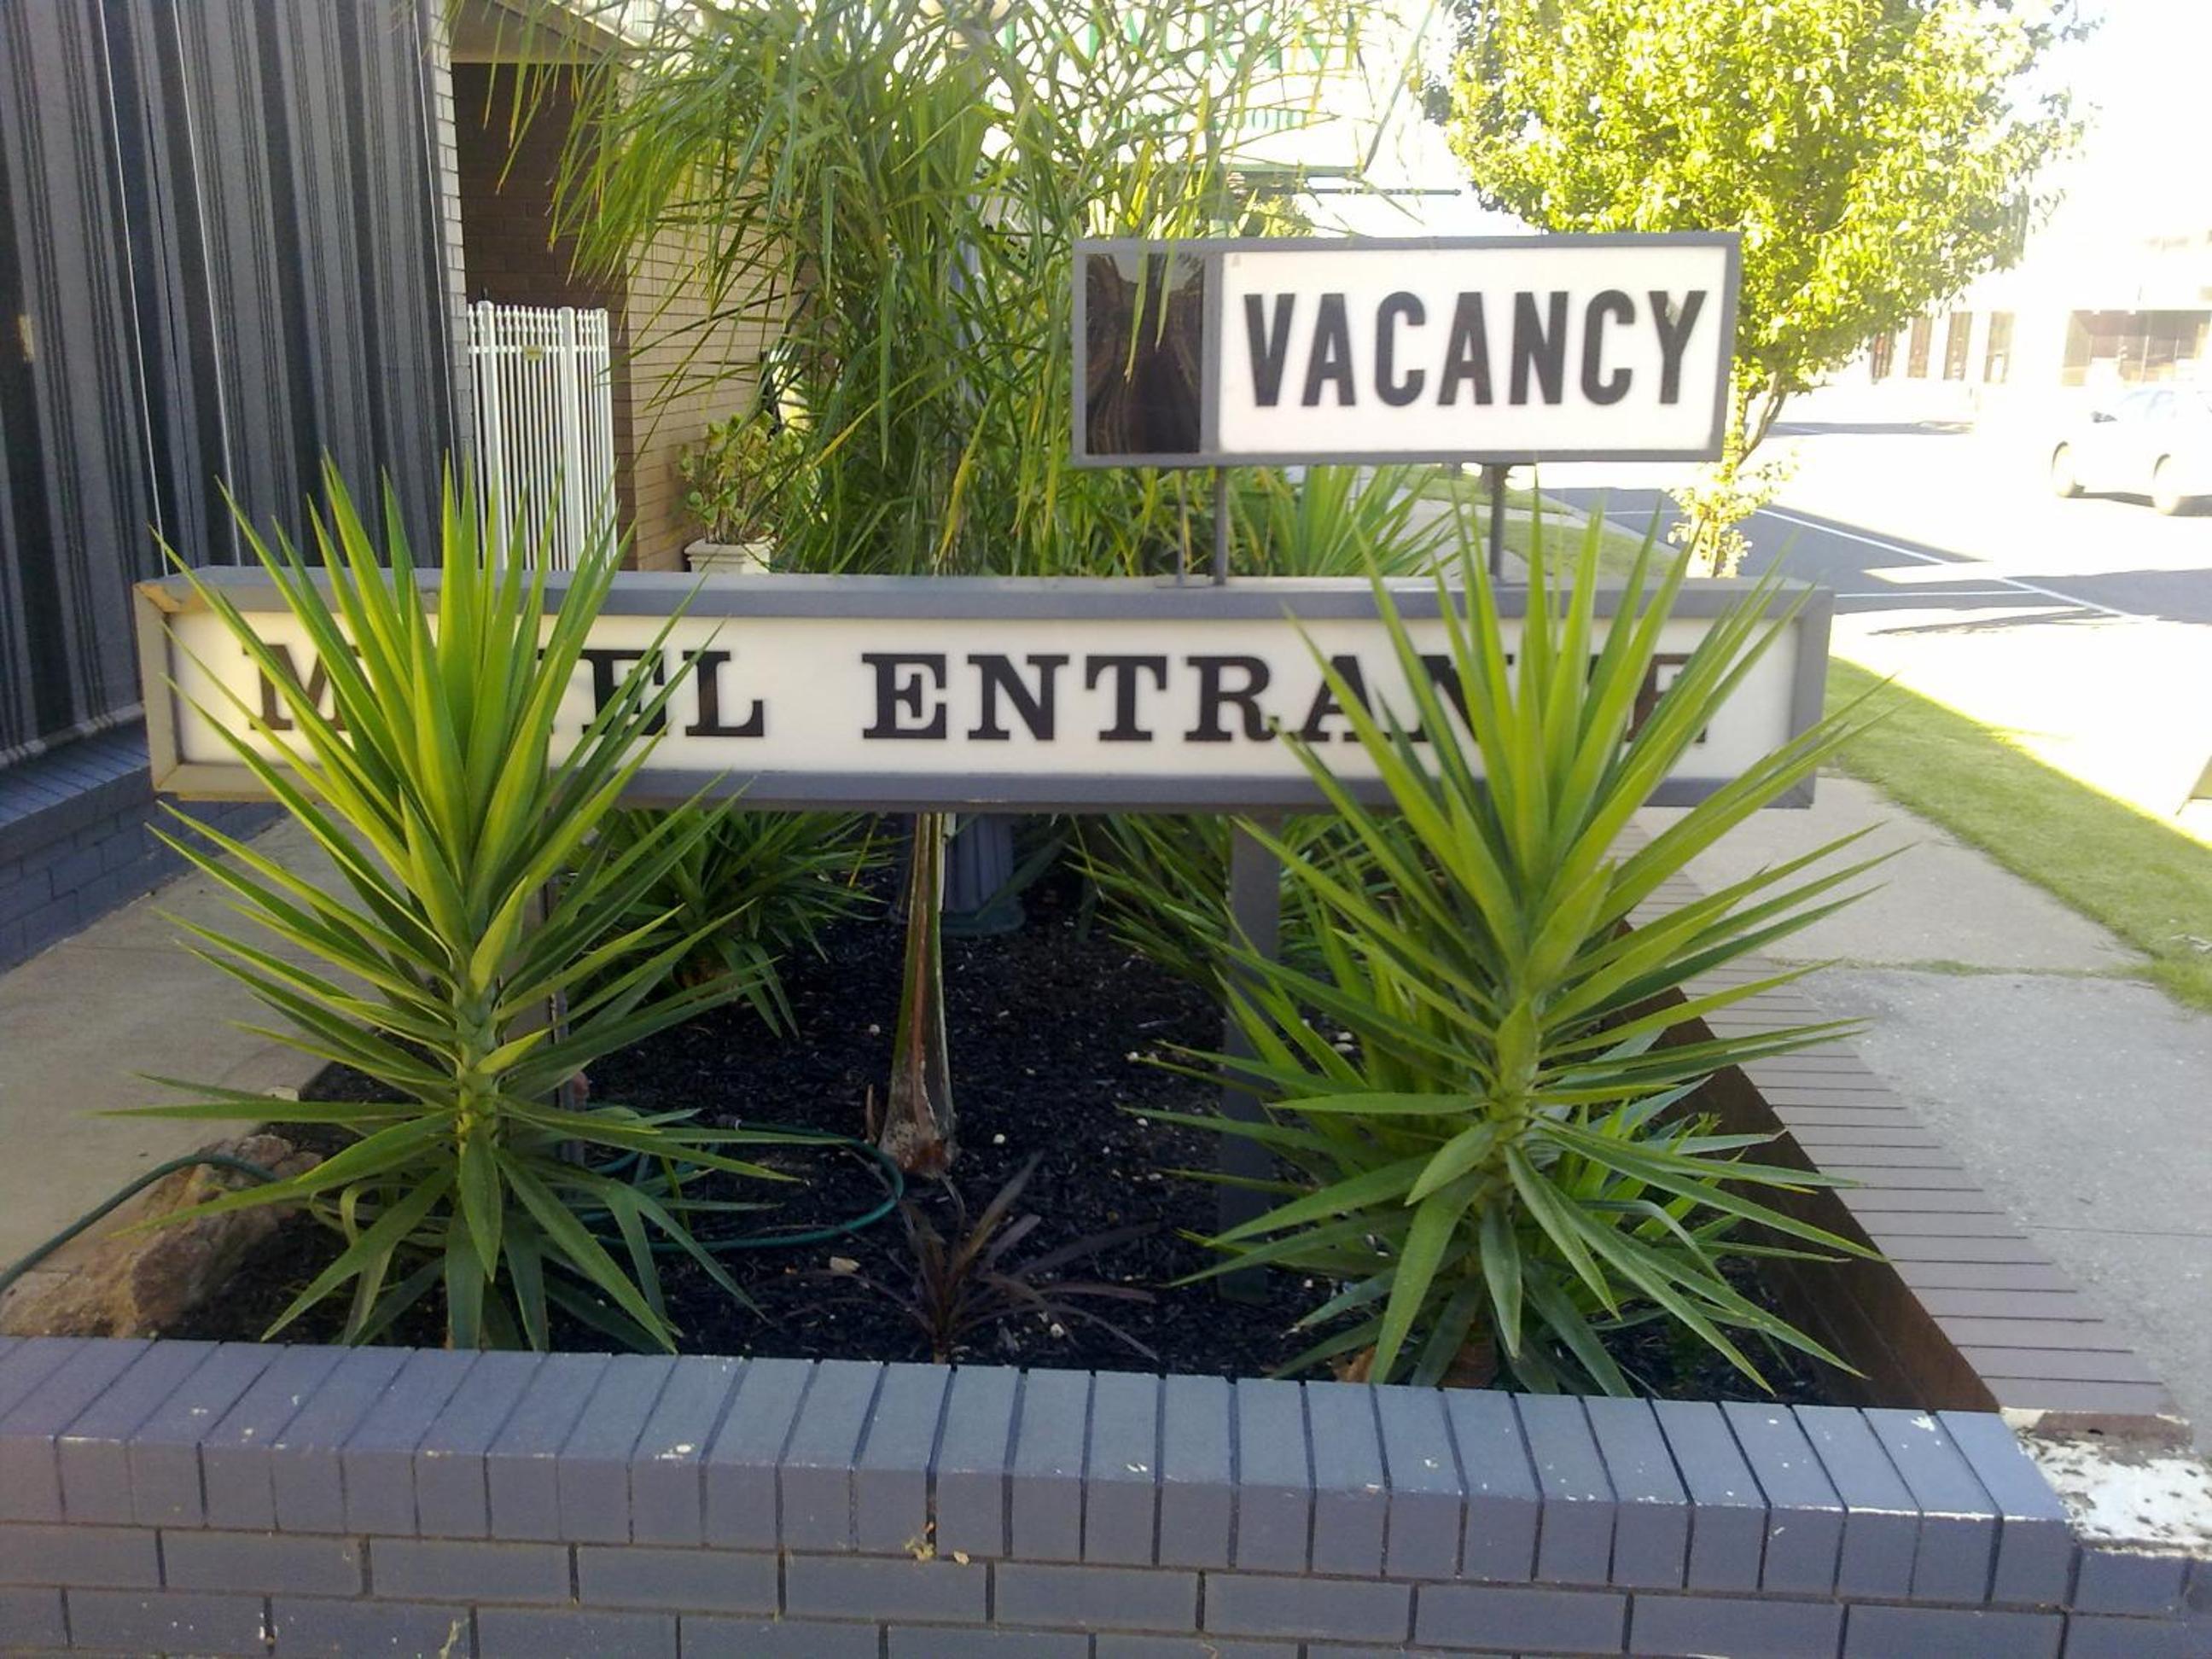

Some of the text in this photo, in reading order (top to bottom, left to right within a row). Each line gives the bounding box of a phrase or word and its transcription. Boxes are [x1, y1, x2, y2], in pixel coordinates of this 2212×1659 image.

[1243, 289, 1708, 408] VACANCY
[242, 643, 1707, 744] MEL ENTRA
